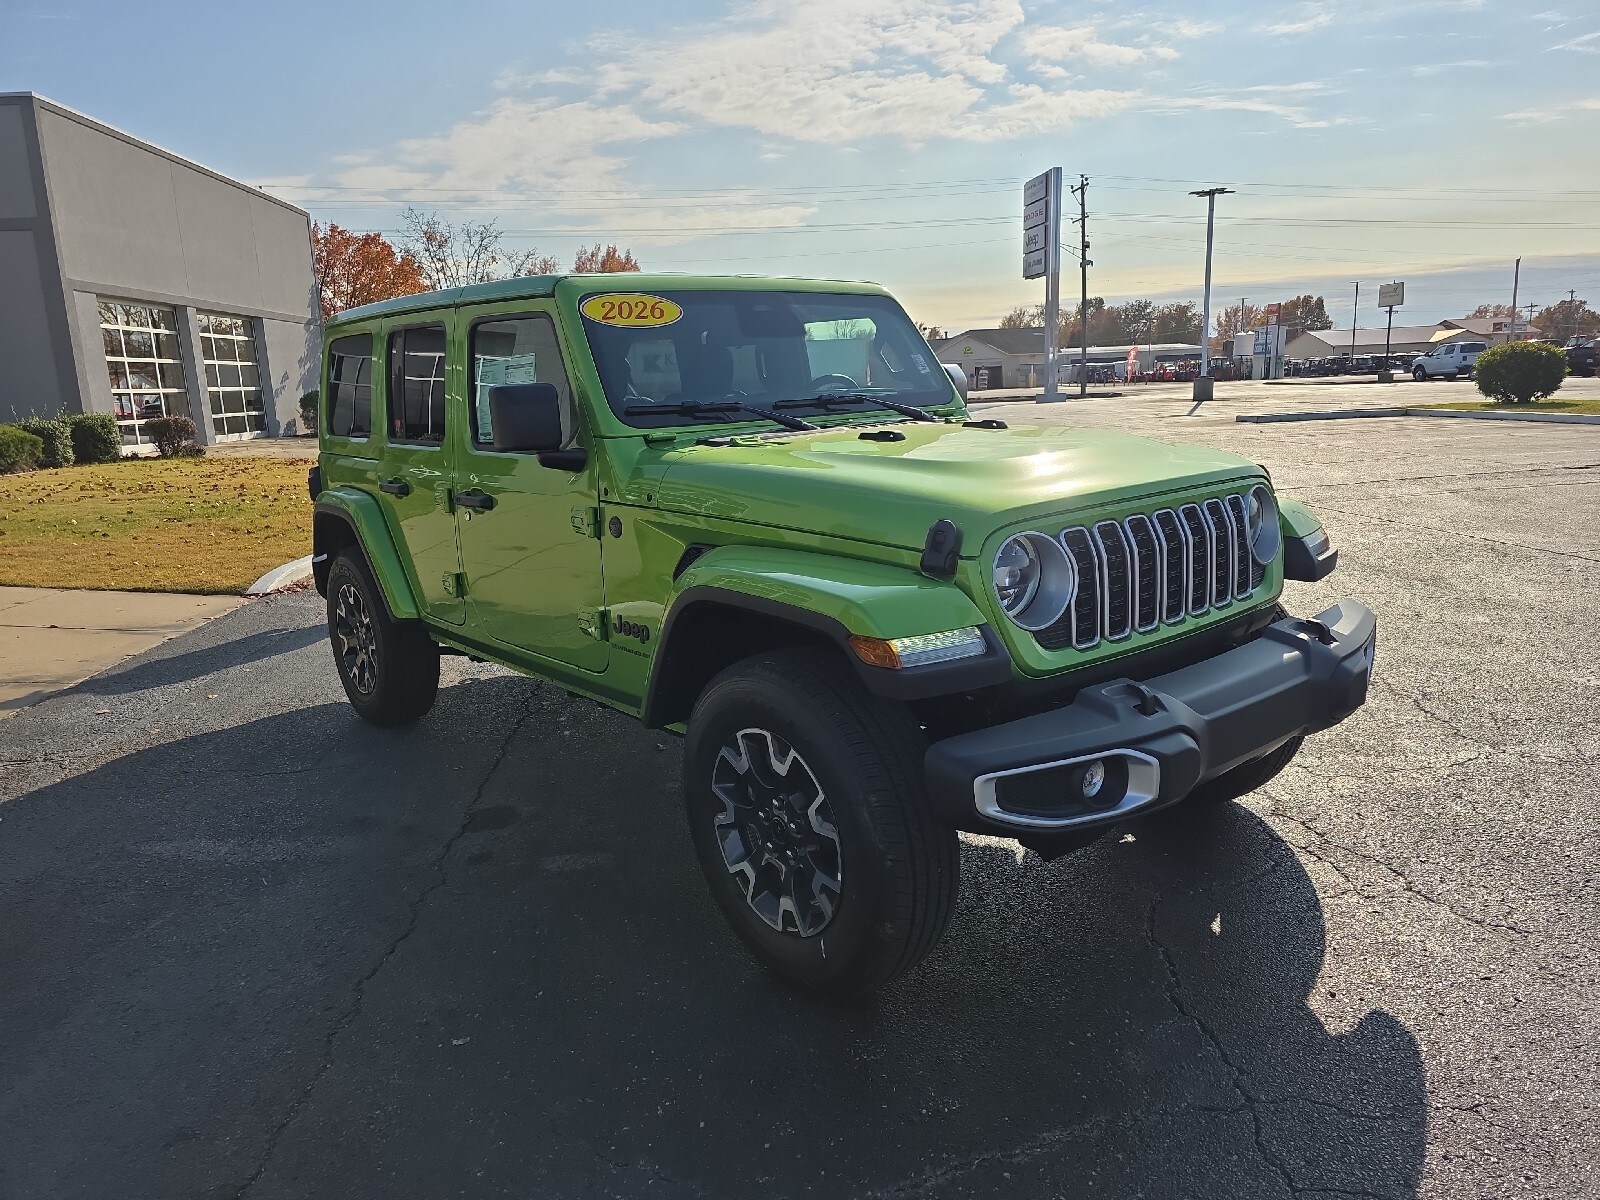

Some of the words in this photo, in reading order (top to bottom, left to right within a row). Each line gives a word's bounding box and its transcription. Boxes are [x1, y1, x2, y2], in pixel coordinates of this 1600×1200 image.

[1025, 233, 1039, 247] Jeep
[600, 301, 665, 320] 2026
[612, 614, 650, 645] Jeep
